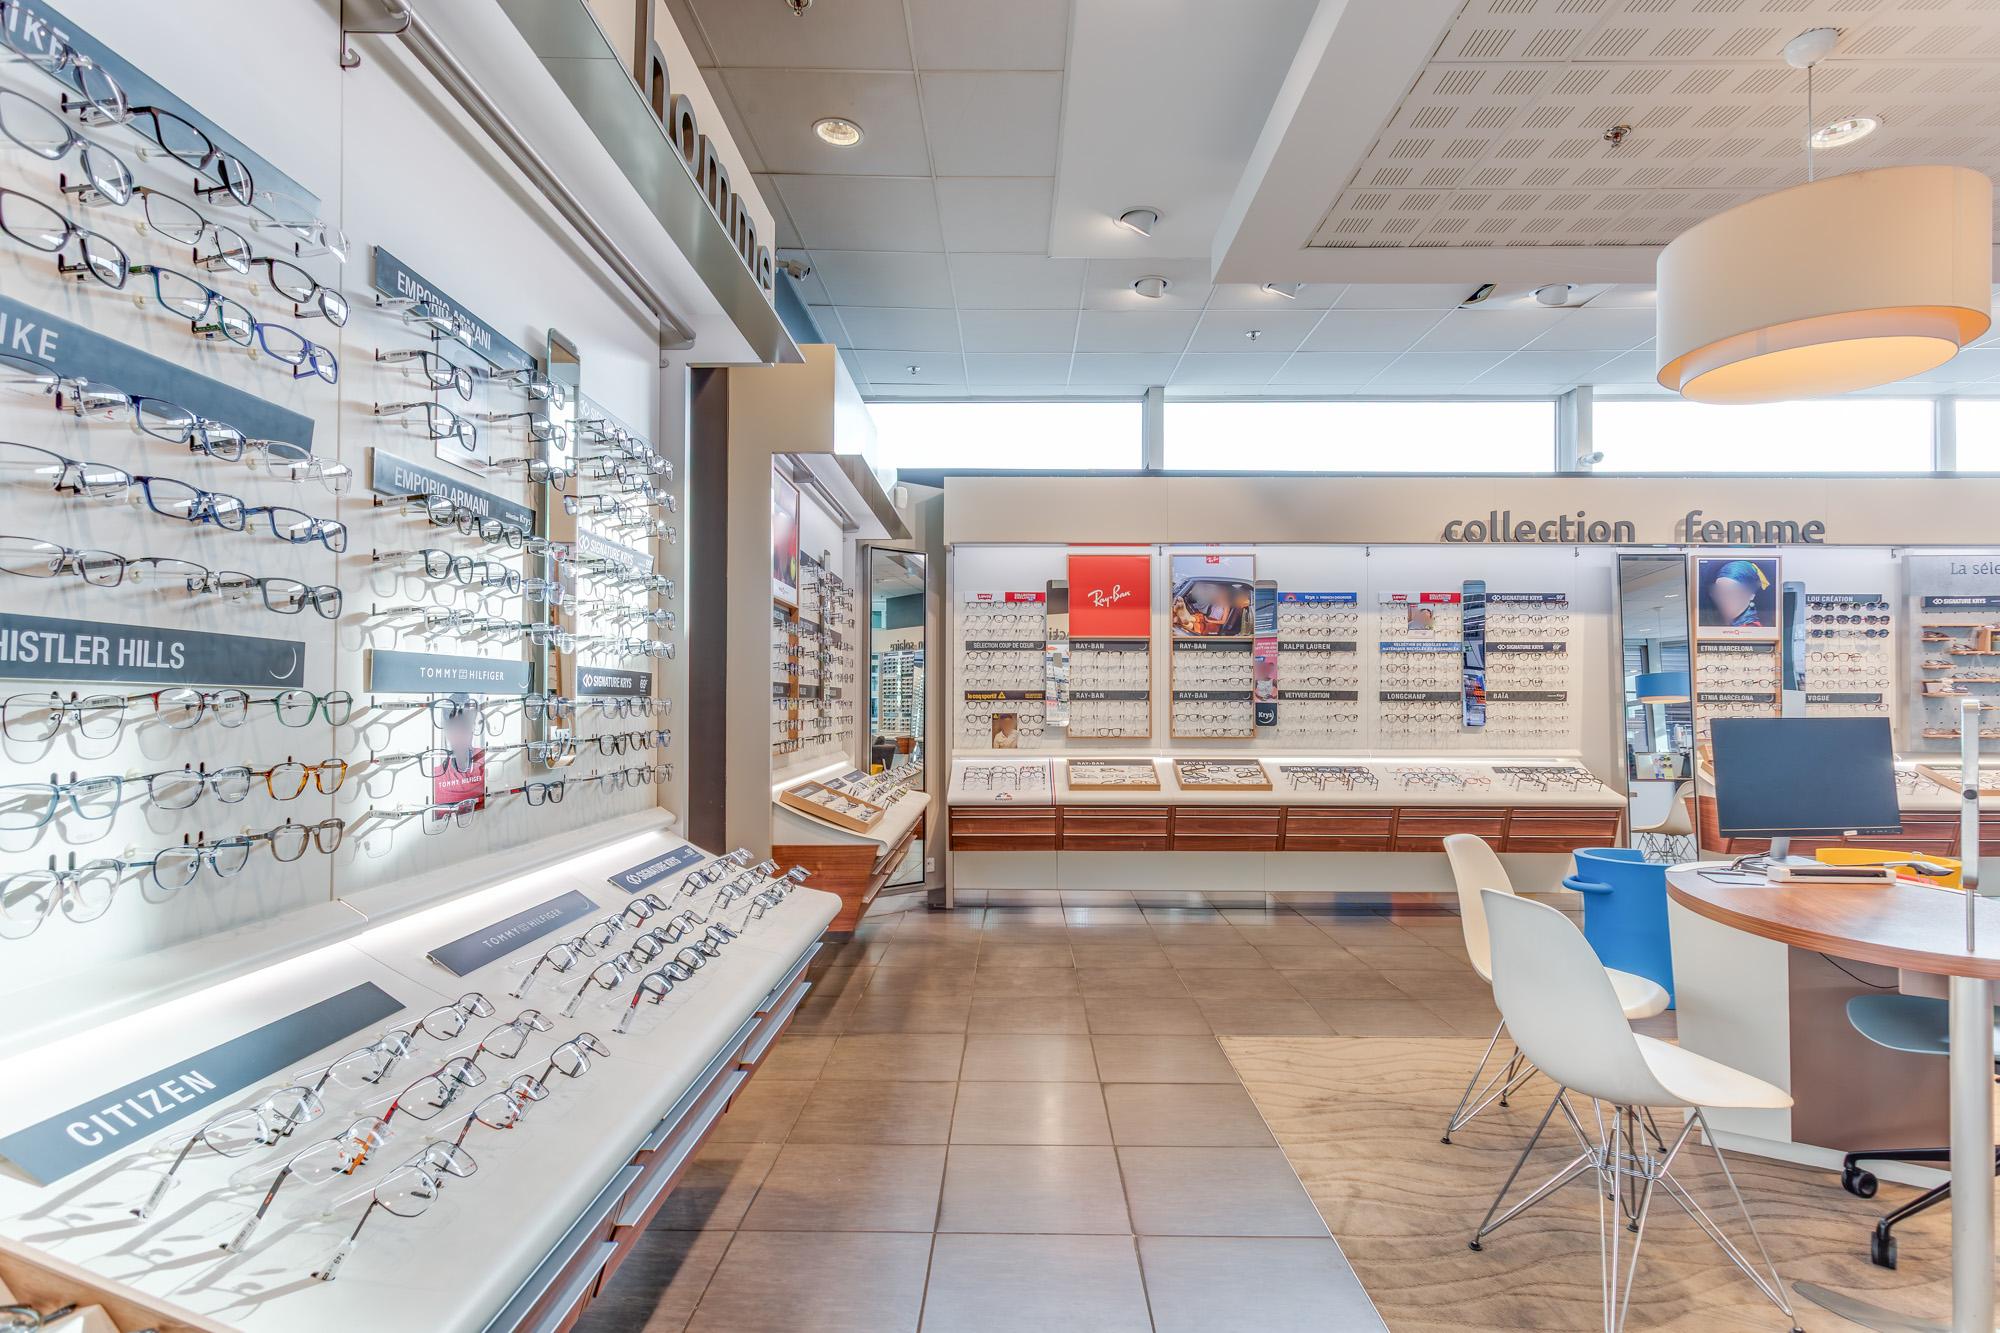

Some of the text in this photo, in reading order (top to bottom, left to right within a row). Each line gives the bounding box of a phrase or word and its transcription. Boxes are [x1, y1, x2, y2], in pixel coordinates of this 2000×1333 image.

[9, 0, 70, 58] IKE
[397, 270, 451, 316] EMPORIO
[0, 312, 59, 363] IKE
[394, 466, 489, 518] EMPORIO ARMANI
[1444, 510, 1825, 543] collection femme
[1951, 562, 2000, 575] La séle
[1087, 584, 1131, 608] Ray-Ban
[118, 638, 185, 670] HILLS
[420, 667, 504, 682] TOMMY HILFIGER
[593, 674, 633, 689] SIGNATURE KRYS
[1258, 711, 1272, 720] Krys
[438, 775, 482, 788] TOMMY HILFIGER
[637, 861, 669, 881] SIGNATURE
[482, 908, 563, 949] TOMMY HILFIGER
[65, 1069, 217, 1148] CITIZEN
